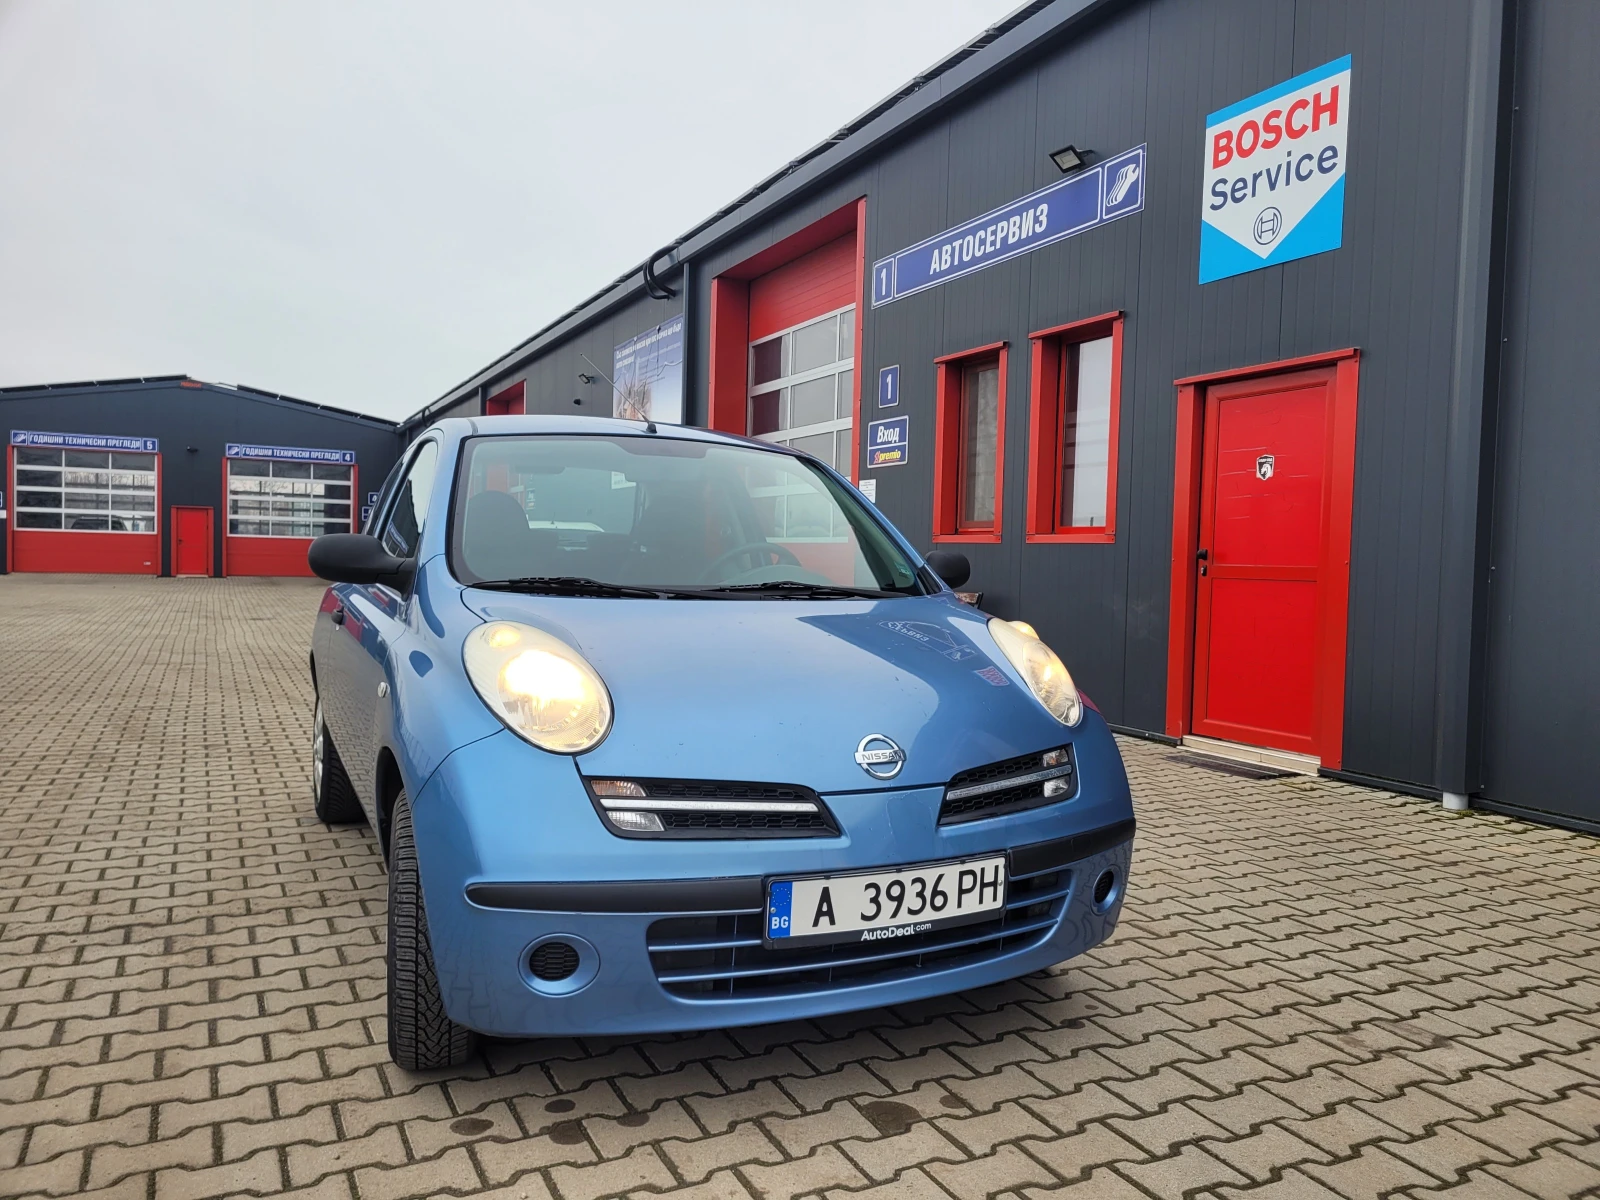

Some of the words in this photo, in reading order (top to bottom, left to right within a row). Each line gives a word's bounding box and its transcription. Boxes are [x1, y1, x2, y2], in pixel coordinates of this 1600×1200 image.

[1212, 84, 1340, 170] BOSCH
[1209, 145, 1339, 211] Service
[880, 268, 887, 296] 1
[929, 203, 1049, 275] АВТОСЕРВИЗ
[886, 374, 892, 399] 1
[29, 434, 64, 444] ГОДИШНИ
[65, 436, 106, 446] ТЕХНИЧЕСКИ
[107, 439, 141, 449] ПРЕГЛЕДИ
[877, 426, 899, 443] Вход
[242, 447, 272, 456] ГОДИШНИ
[273, 449, 309, 458] ТЕХНИЧЕСКИ
[310, 451, 340, 460] ПРЕГЛЕДИ
[344, 453, 350, 461] 4
[879, 449, 901, 463] premio
[861, 750, 902, 761] NISSAN
[812, 886, 836, 927] A
[860, 873, 948, 922] 3936
[956, 864, 999, 909] PH
[771, 916, 789, 929] BG
